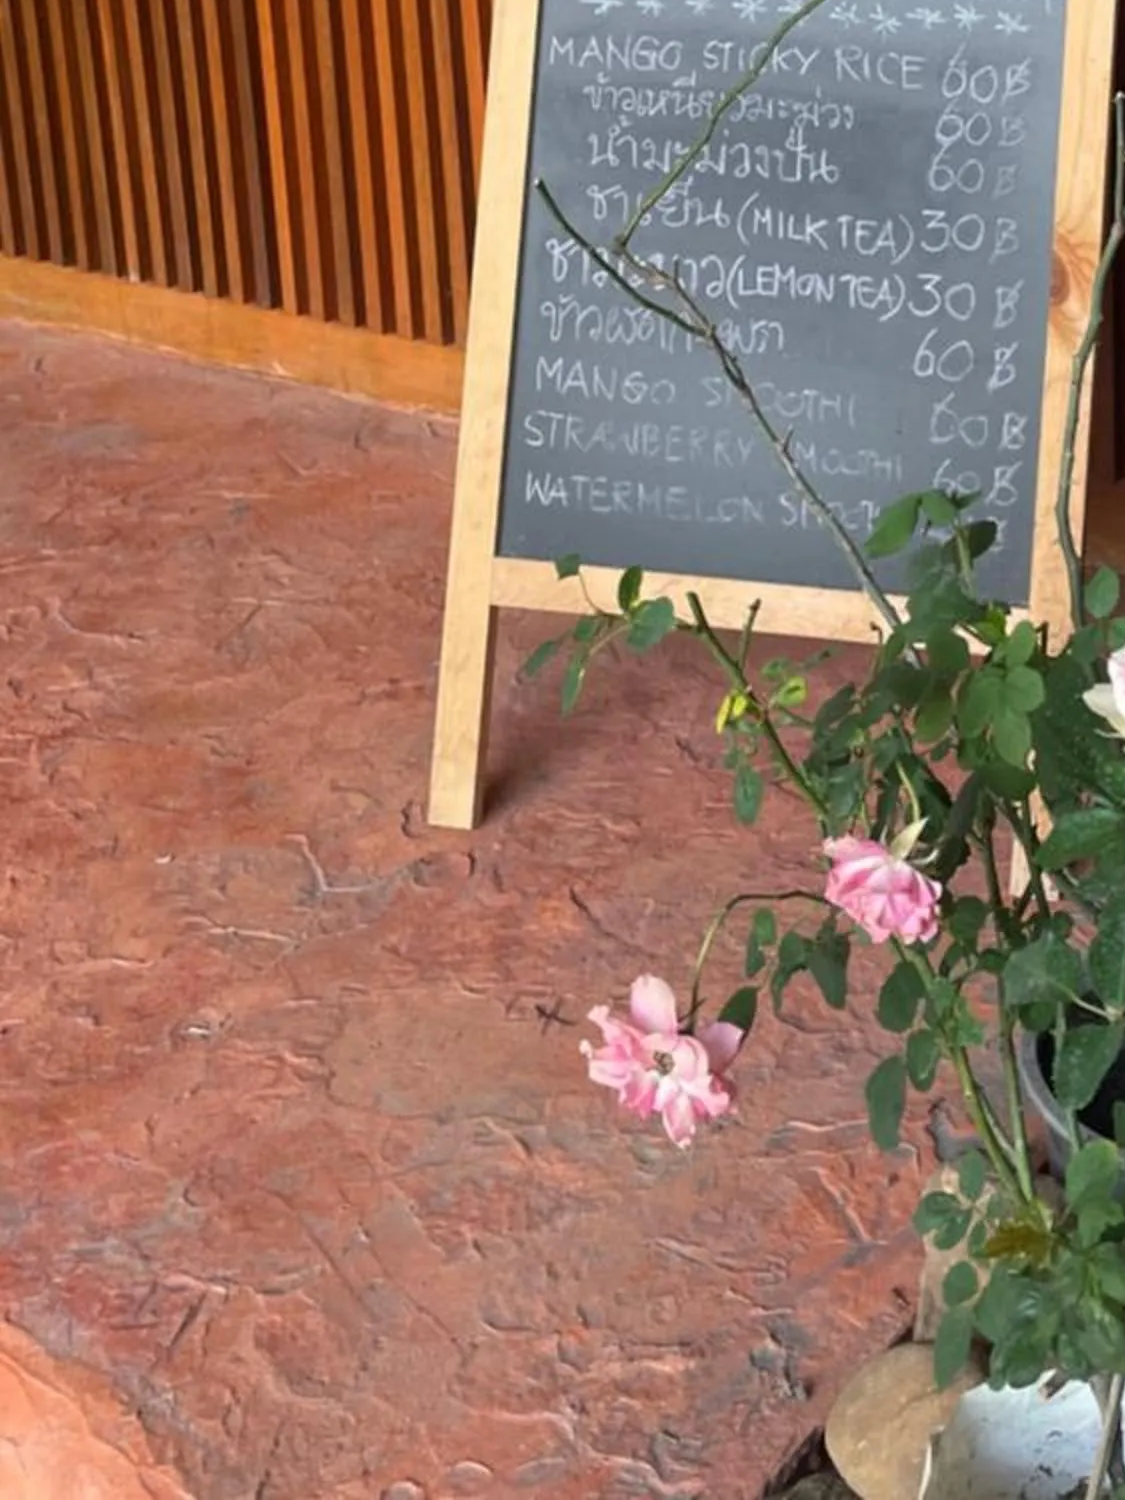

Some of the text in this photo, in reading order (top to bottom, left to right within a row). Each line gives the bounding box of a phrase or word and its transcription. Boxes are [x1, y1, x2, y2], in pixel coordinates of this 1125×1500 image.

[547, 35, 685, 72] MANGO
[702, 40, 821, 76] STICKY
[834, 45, 928, 91] RICE
[920, 208, 986, 252] 30
[906, 273, 977, 322] 30
[912, 327, 975, 382] 60
[535, 355, 677, 405] MANGO
